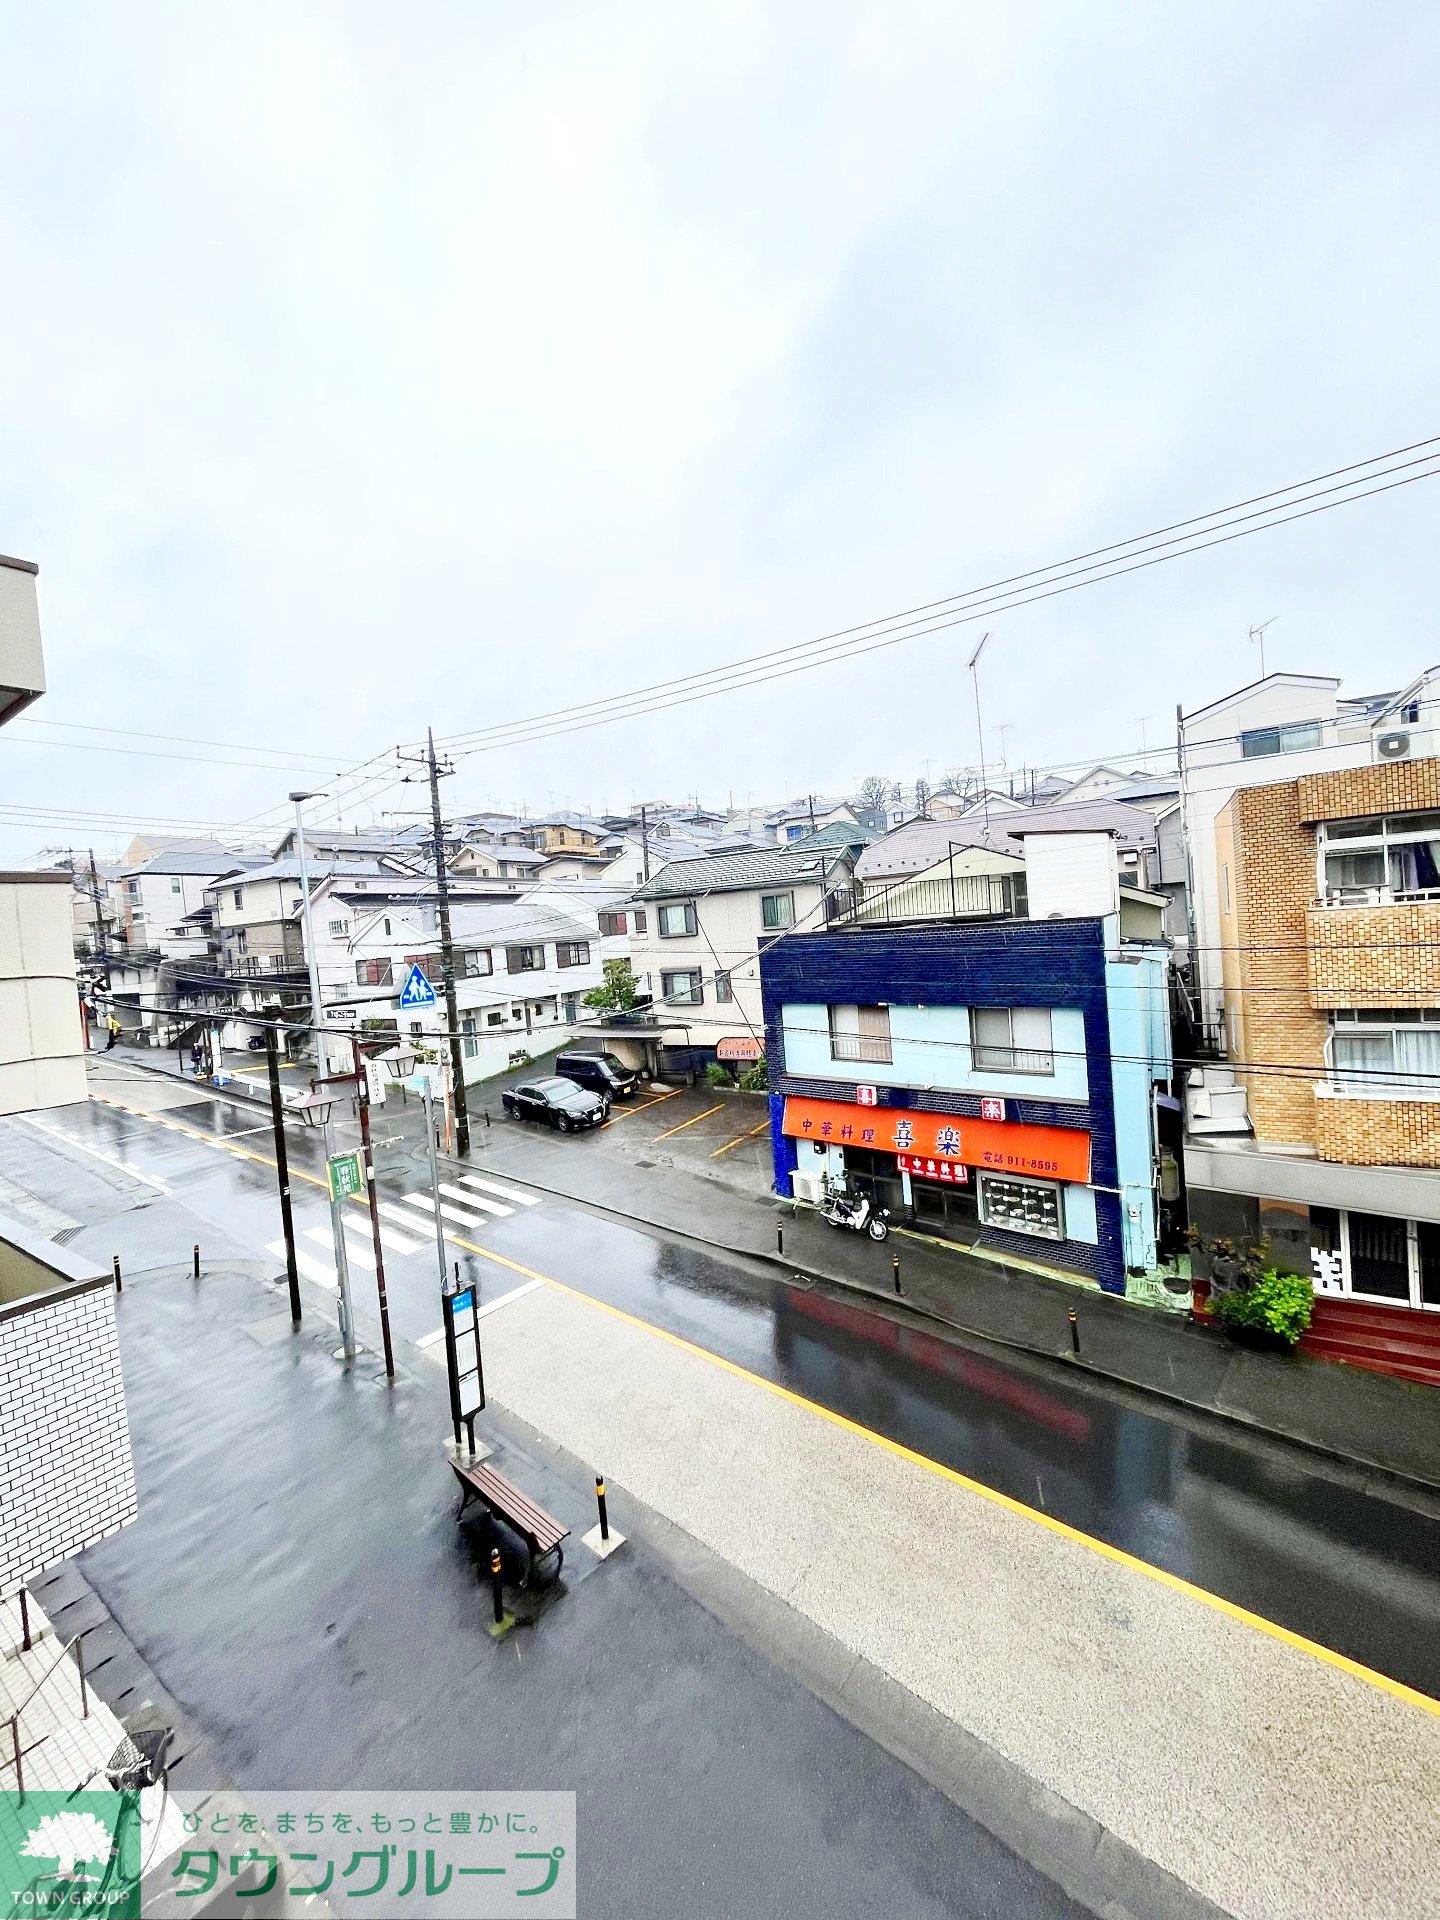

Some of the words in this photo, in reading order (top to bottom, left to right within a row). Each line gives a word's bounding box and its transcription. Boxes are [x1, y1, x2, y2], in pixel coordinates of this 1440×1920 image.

[858, 1087, 873, 1105] 喜
[984, 1100, 1001, 1119] 楽
[802, 1117, 875, 1144] 中華料理
[891, 1119, 962, 1157] 喜楽
[983, 1151, 1004, 1165] 電話
[1007, 1155, 1058, 1172] 911-8595
